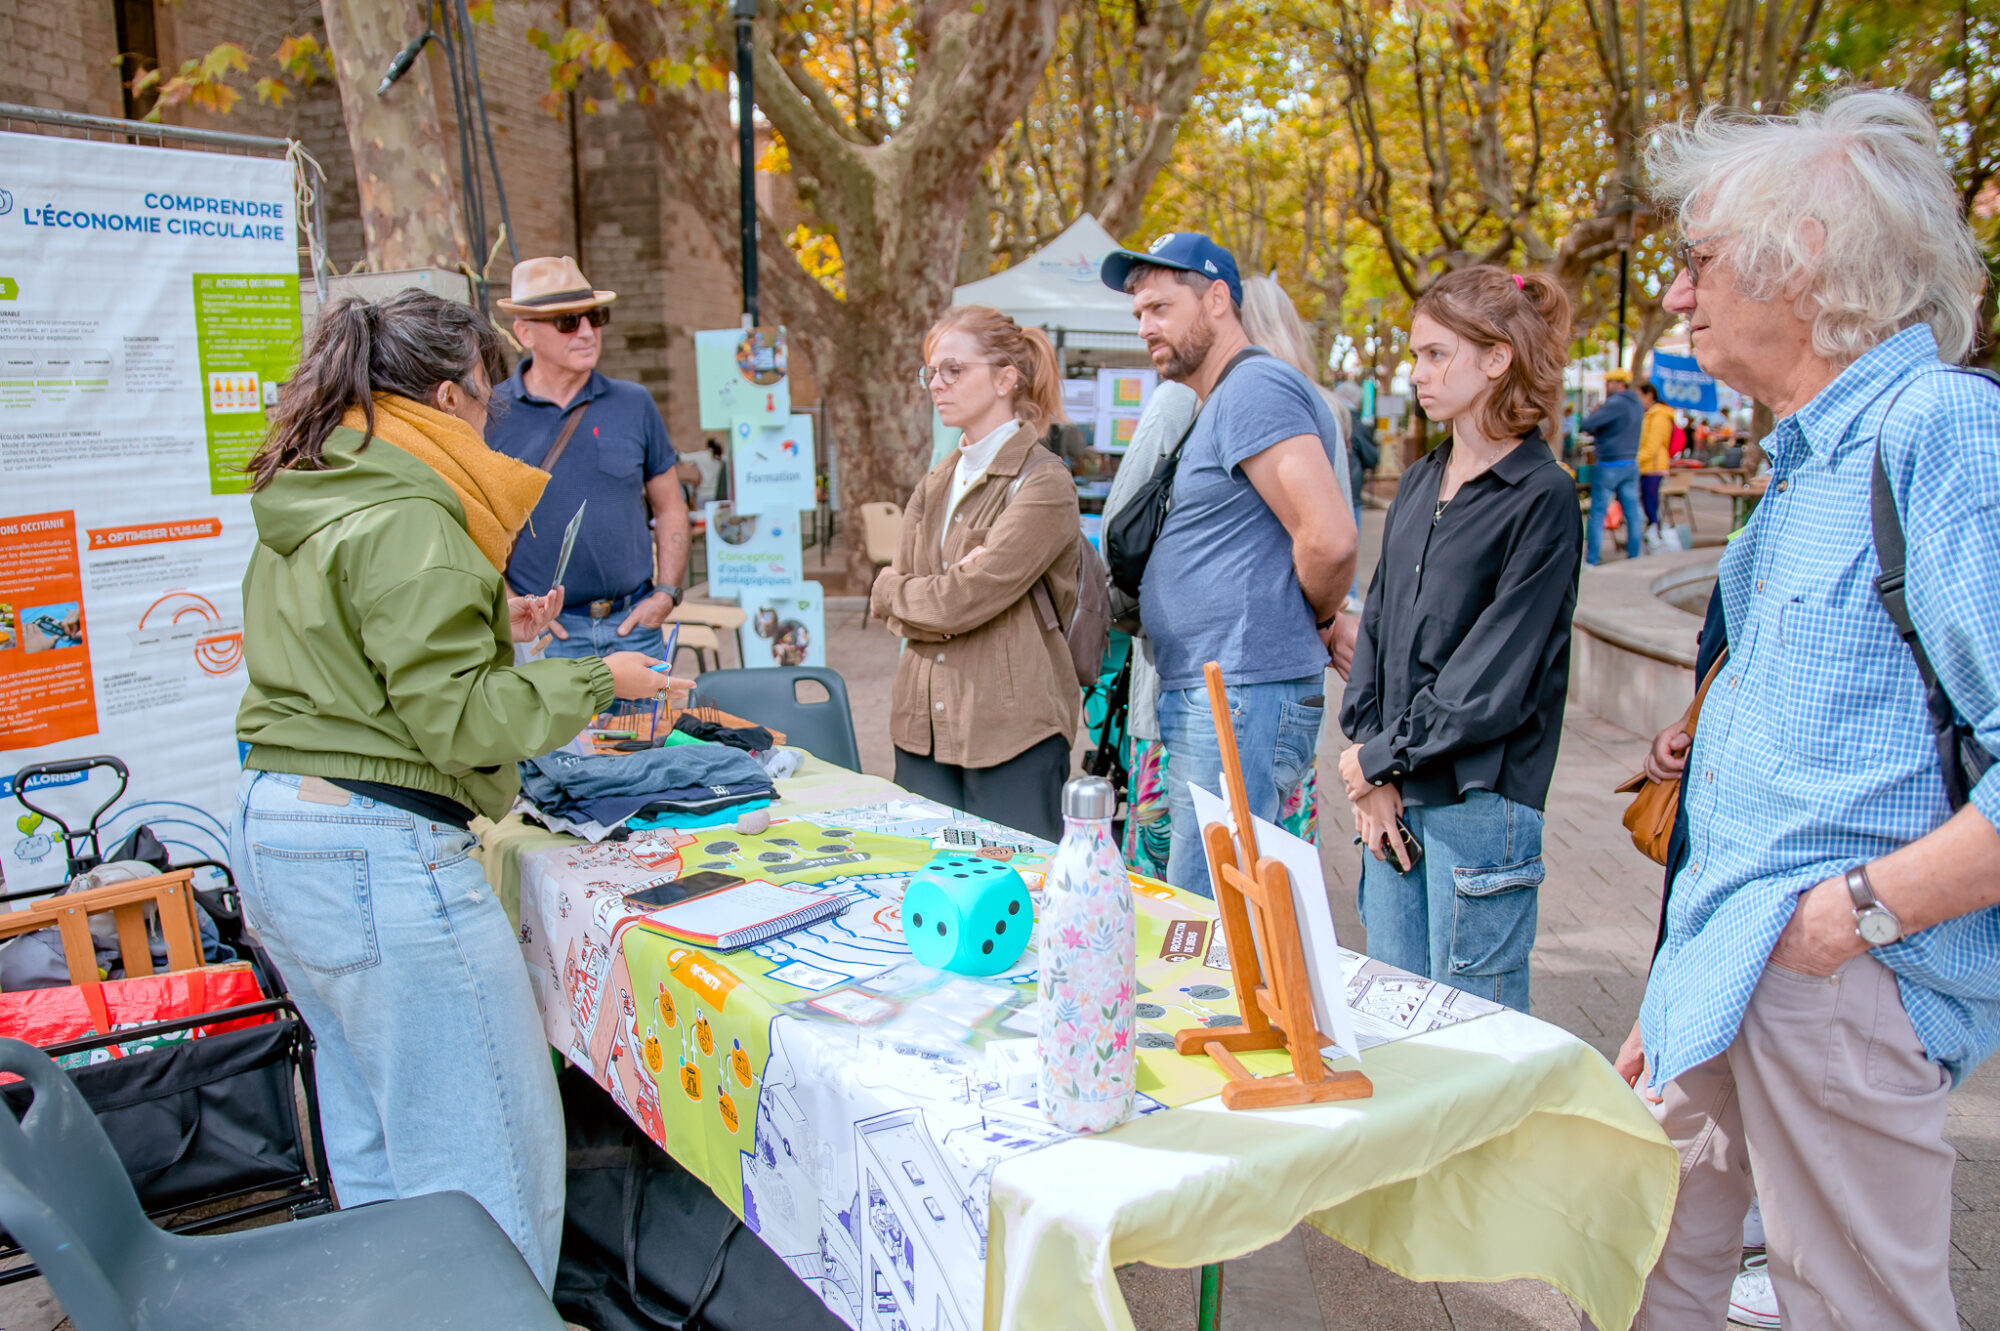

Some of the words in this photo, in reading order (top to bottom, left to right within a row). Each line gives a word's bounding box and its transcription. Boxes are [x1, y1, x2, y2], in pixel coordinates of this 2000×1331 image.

[144, 193, 283, 218] COMPRENDRE
[167, 218, 284, 240] CIRCULAIRE
[746, 472, 800, 483] Formation
[20, 518, 65, 533] OCCITANIE
[95, 534, 106, 545] 2.
[108, 527, 167, 543] OPTIMISER
[717, 551, 784, 562] Conception
[1169, 922, 1187, 953] PRODUCTION
